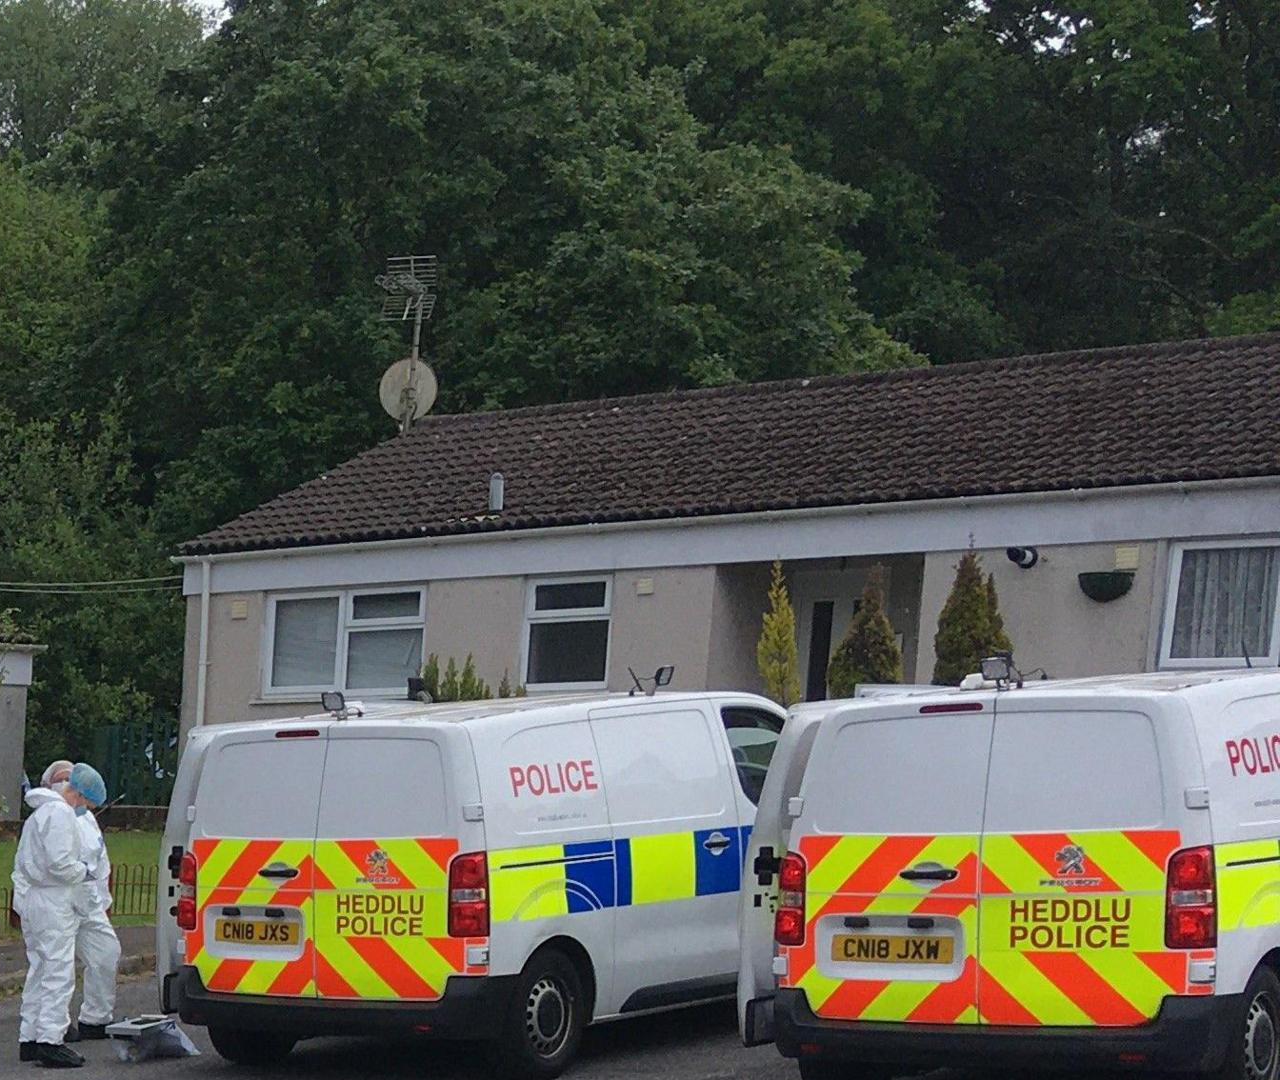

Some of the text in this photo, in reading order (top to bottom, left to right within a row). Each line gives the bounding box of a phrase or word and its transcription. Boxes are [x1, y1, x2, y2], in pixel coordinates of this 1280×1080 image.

[509, 760, 598, 797] POLICE
[336, 894, 424, 915] HEDDLU
[1010, 899, 1131, 923] HEDDLU
[223, 923, 289, 942] CN18 JXS
[336, 916, 423, 936] POLICE
[1010, 925, 1130, 949] POLICE
[844, 939, 939, 960] CN18 JXW
